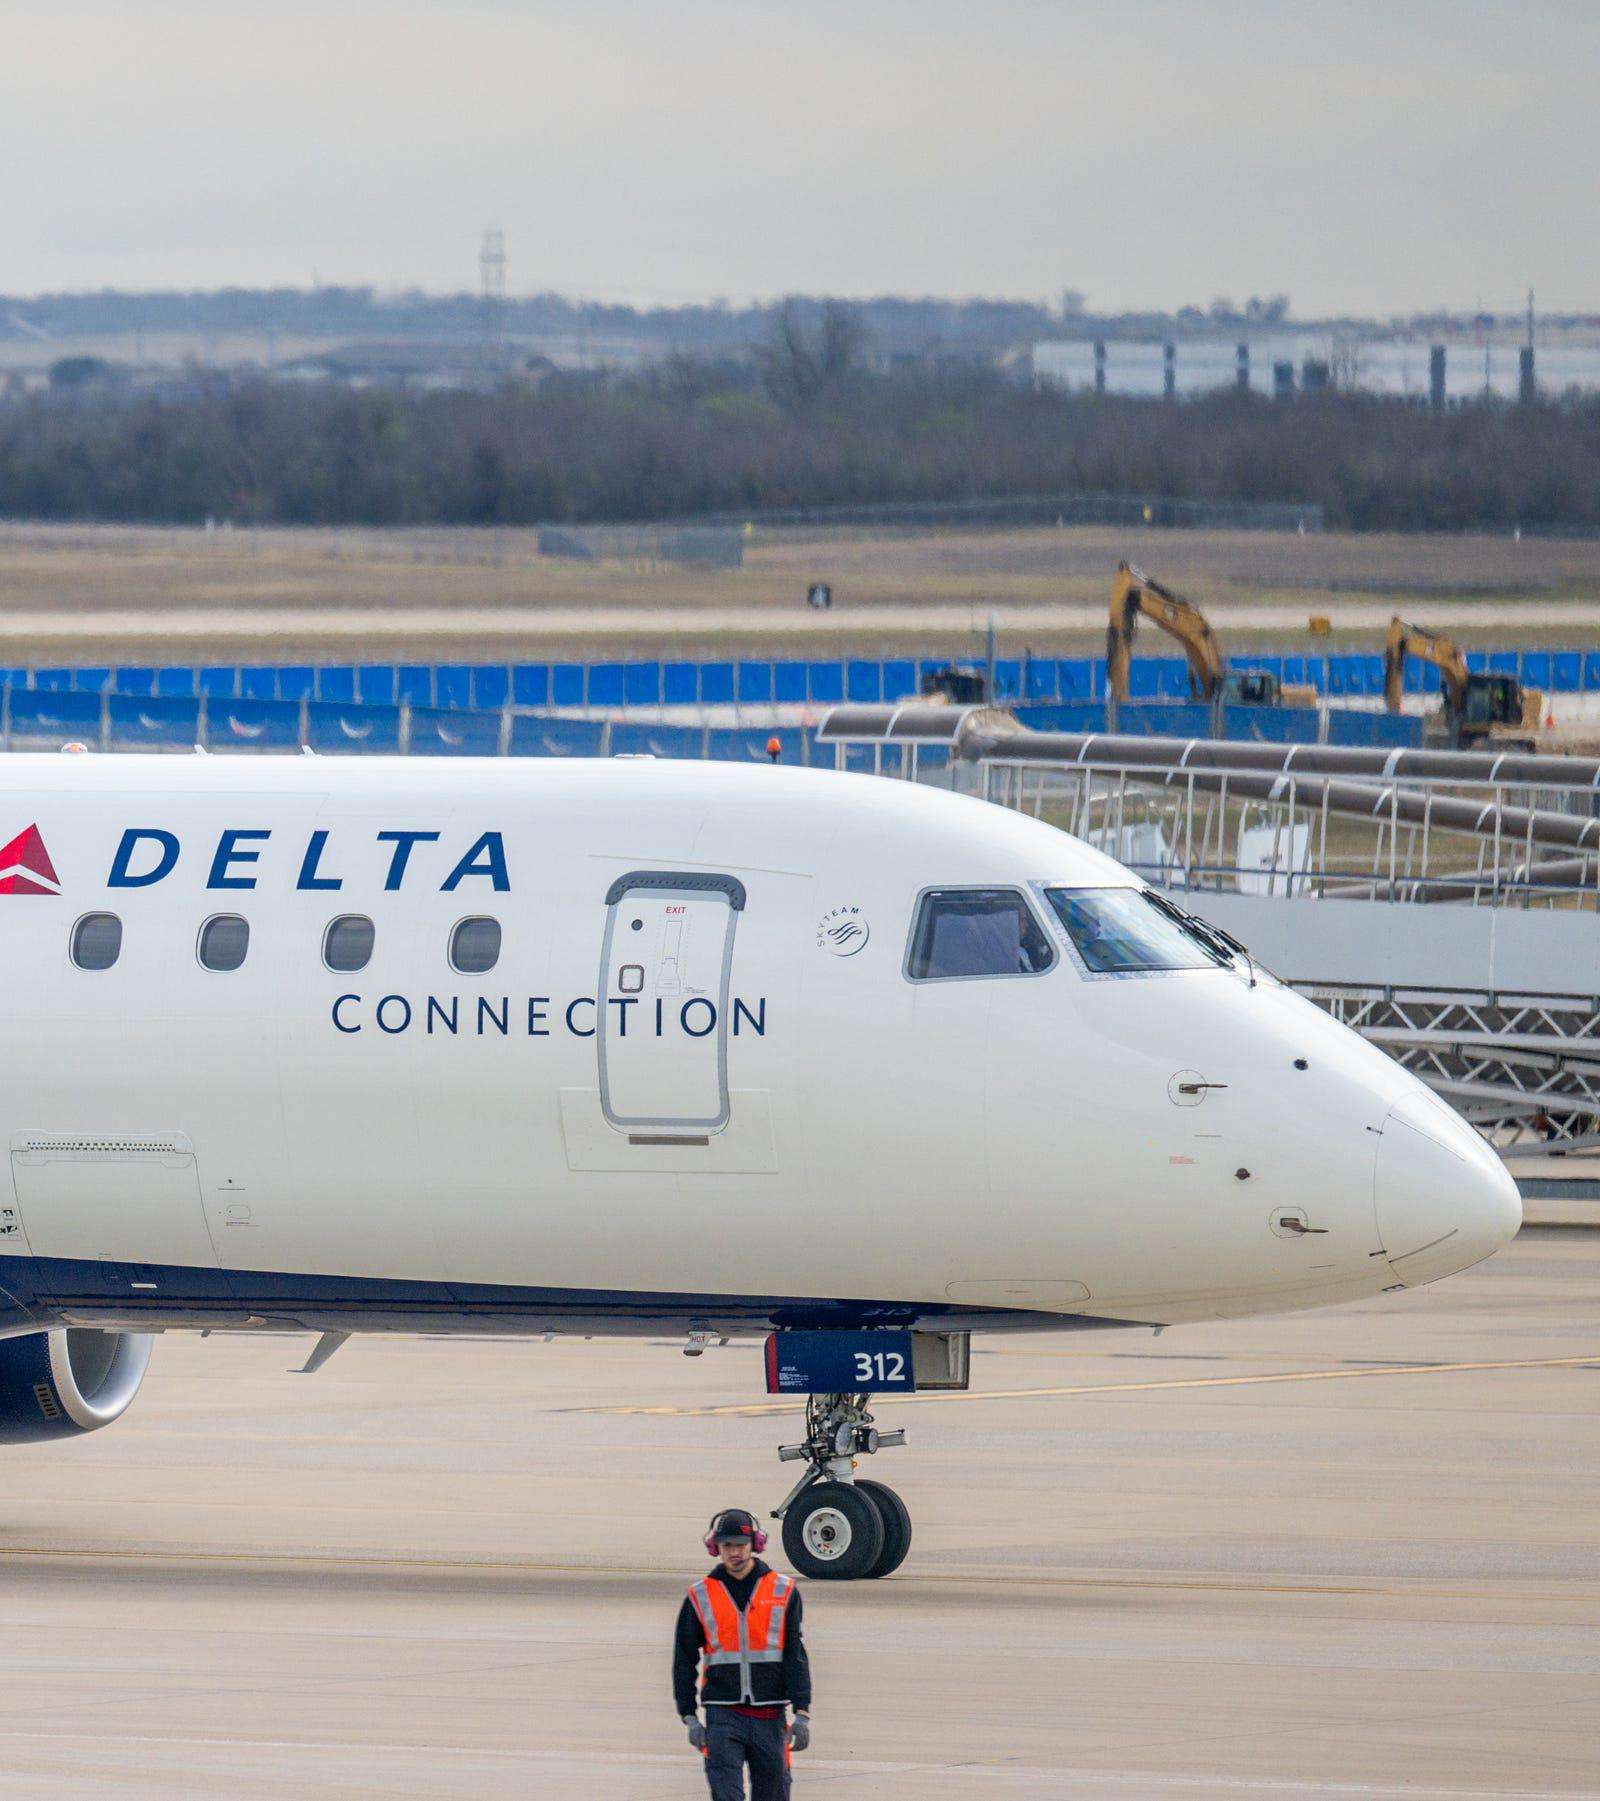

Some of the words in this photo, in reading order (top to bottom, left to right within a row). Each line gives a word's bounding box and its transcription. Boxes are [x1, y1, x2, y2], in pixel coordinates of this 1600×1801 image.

[107, 829, 511, 892] DELTA
[665, 906, 687, 914] EXIT
[816, 906, 860, 947] SKYTEAM
[331, 994, 766, 1038] CONNECTION
[853, 1352, 906, 1382] 312
